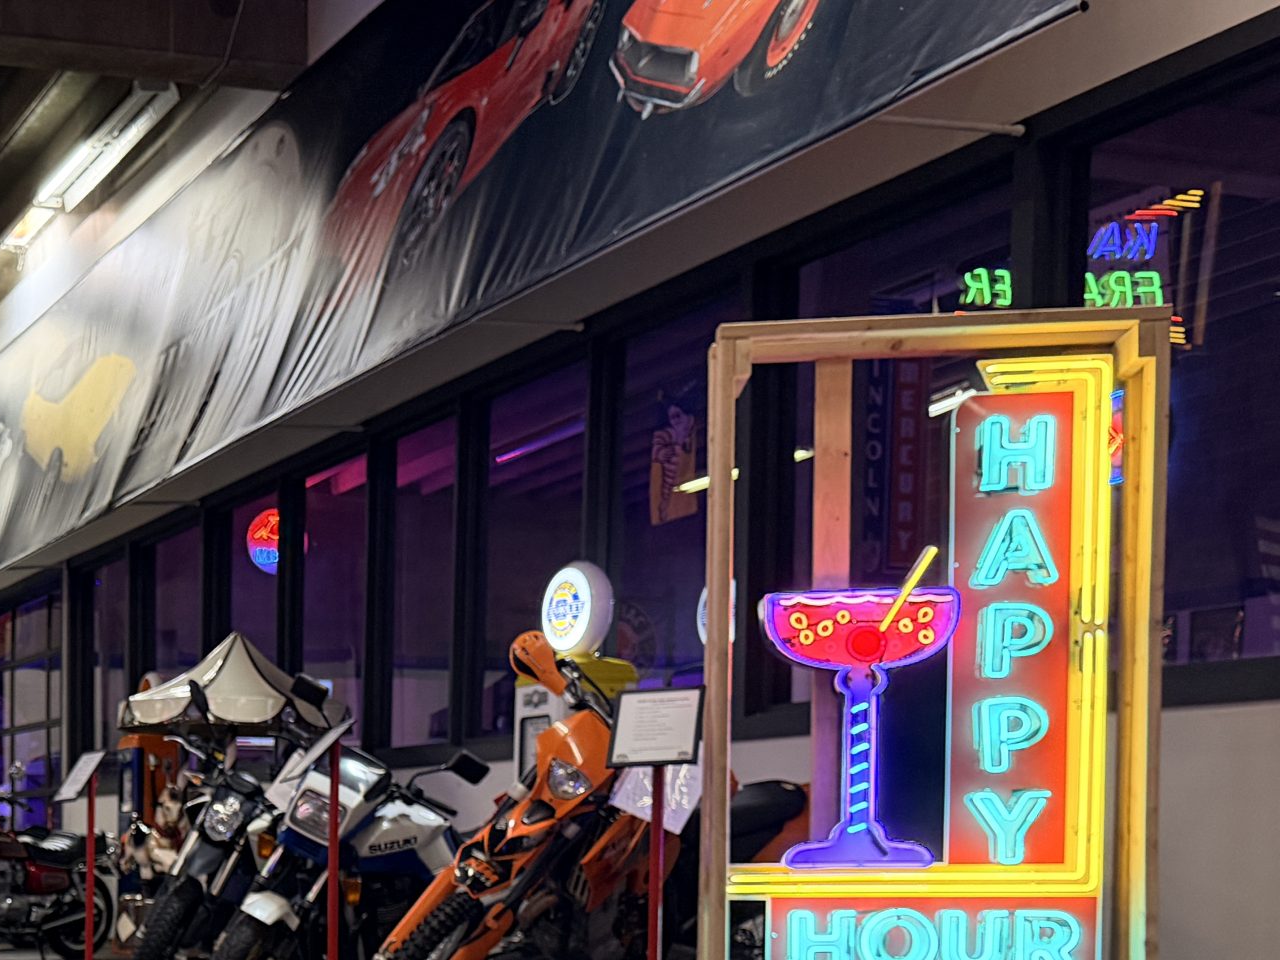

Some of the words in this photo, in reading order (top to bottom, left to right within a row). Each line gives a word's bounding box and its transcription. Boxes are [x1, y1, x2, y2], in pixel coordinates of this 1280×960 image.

[864, 359, 883, 518] INCOLN
[963, 412, 1060, 866] HAPPY
[368, 833, 419, 855] SUZUKI
